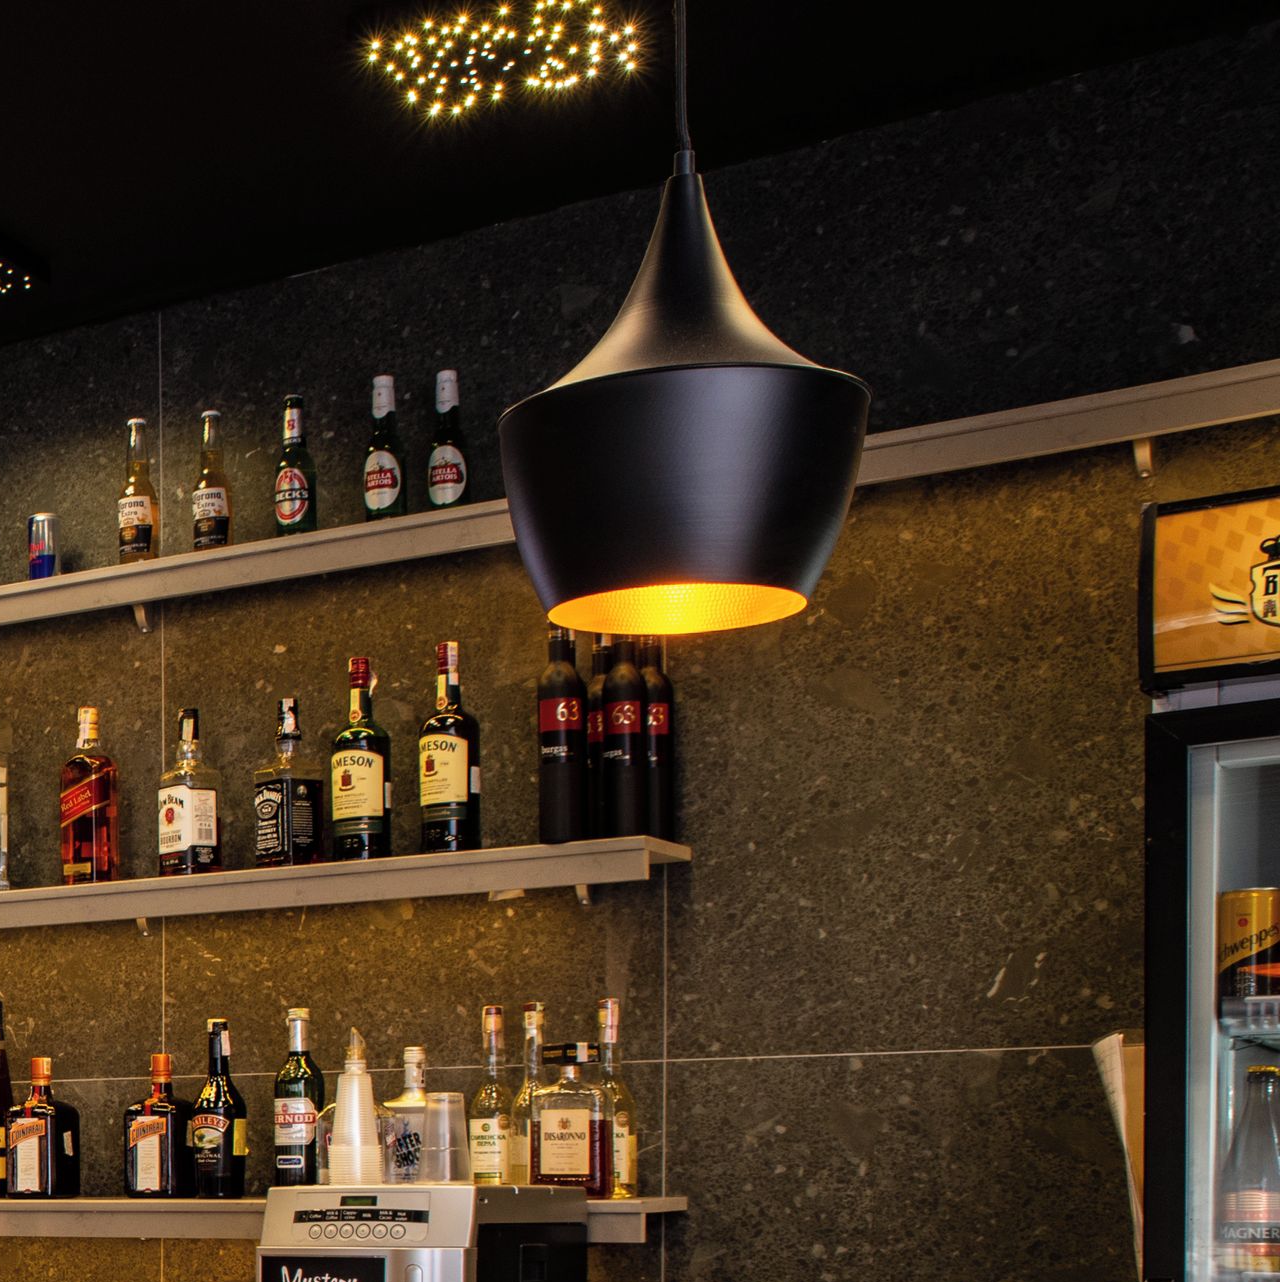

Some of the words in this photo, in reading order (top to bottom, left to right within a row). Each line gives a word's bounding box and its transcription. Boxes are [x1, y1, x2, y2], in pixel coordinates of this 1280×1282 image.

[367, 471, 391, 482] STELLA
[432, 467, 457, 476] STELLA
[432, 473, 458, 482] ARTOIS
[366, 478, 393, 487] ARTOIS
[556, 700, 579, 721] 63
[611, 704, 636, 725] 63
[420, 740, 457, 753] MESON
[333, 756, 374, 769] AMESON
[61, 798, 73, 812] Red
[73, 790, 92, 807] Label
[192, 1116, 226, 1129] AILEYS
[275, 1114, 314, 1123] ERNOD
[11, 1122, 45, 1141] COINTREAU
[132, 1121, 165, 1142] COINTREAU
[544, 1132, 586, 1141] DISARONNO
[1221, 1226, 1280, 1239] MAGNER
